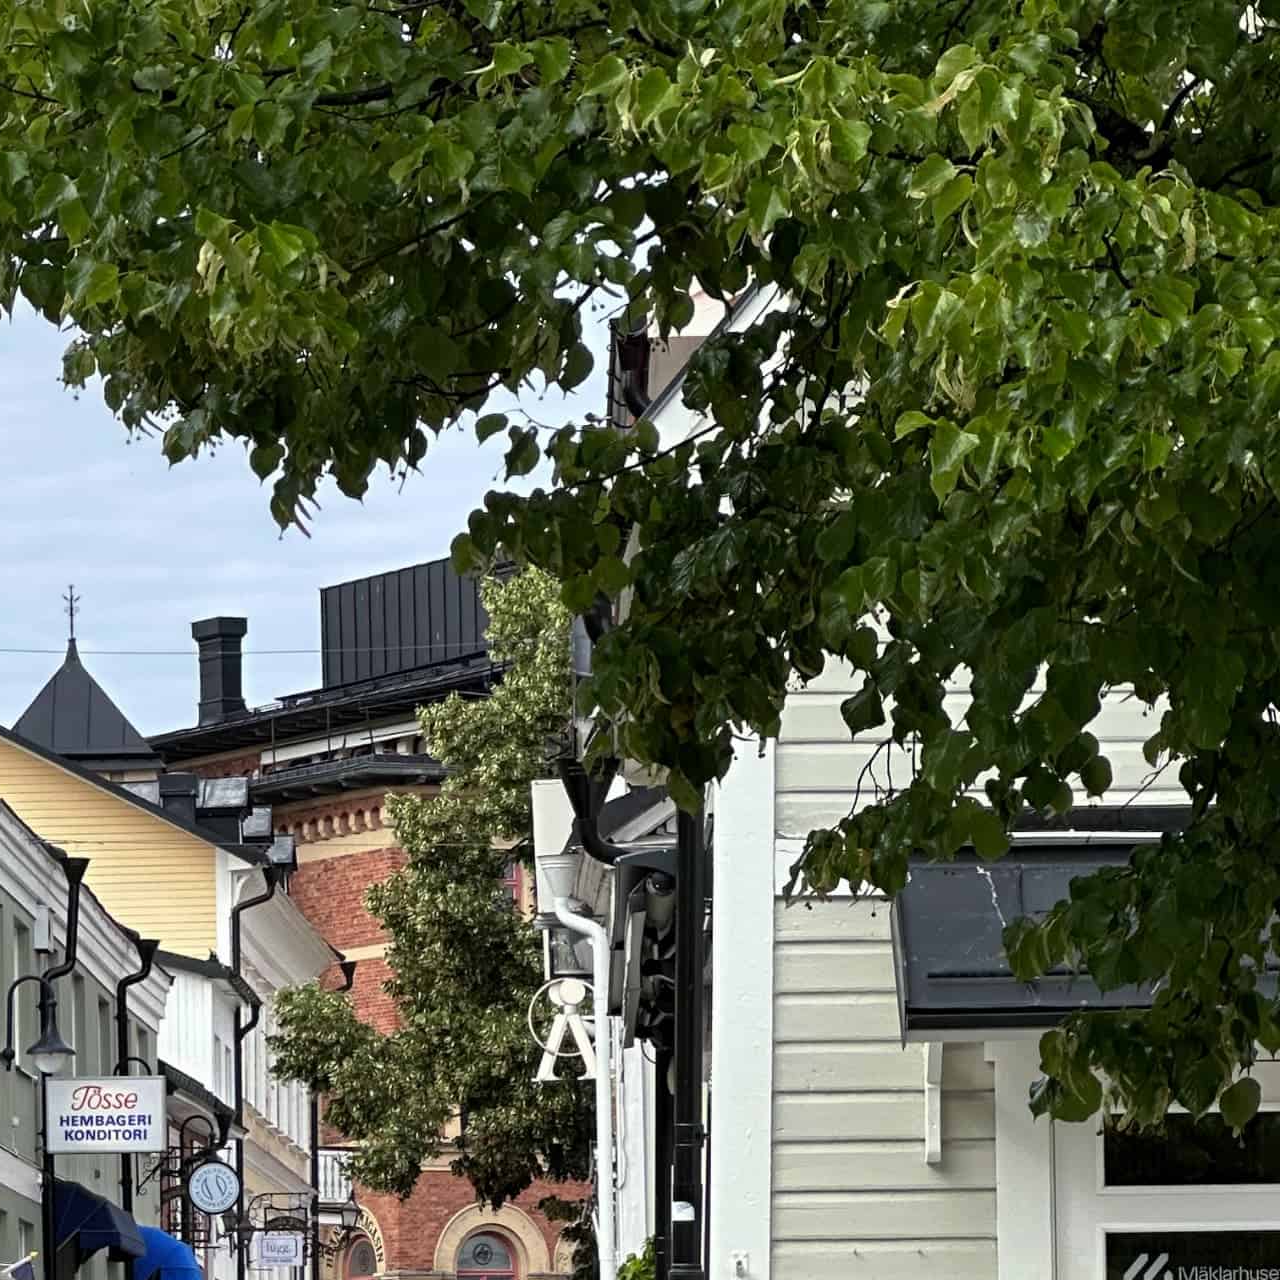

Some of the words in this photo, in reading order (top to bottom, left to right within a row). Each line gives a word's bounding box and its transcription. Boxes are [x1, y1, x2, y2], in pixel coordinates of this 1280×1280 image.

[71, 1085, 138, 1111] Tösse
[59, 1114, 152, 1127] HEMBAGERI
[64, 1129, 148, 1141] KONDITORI
